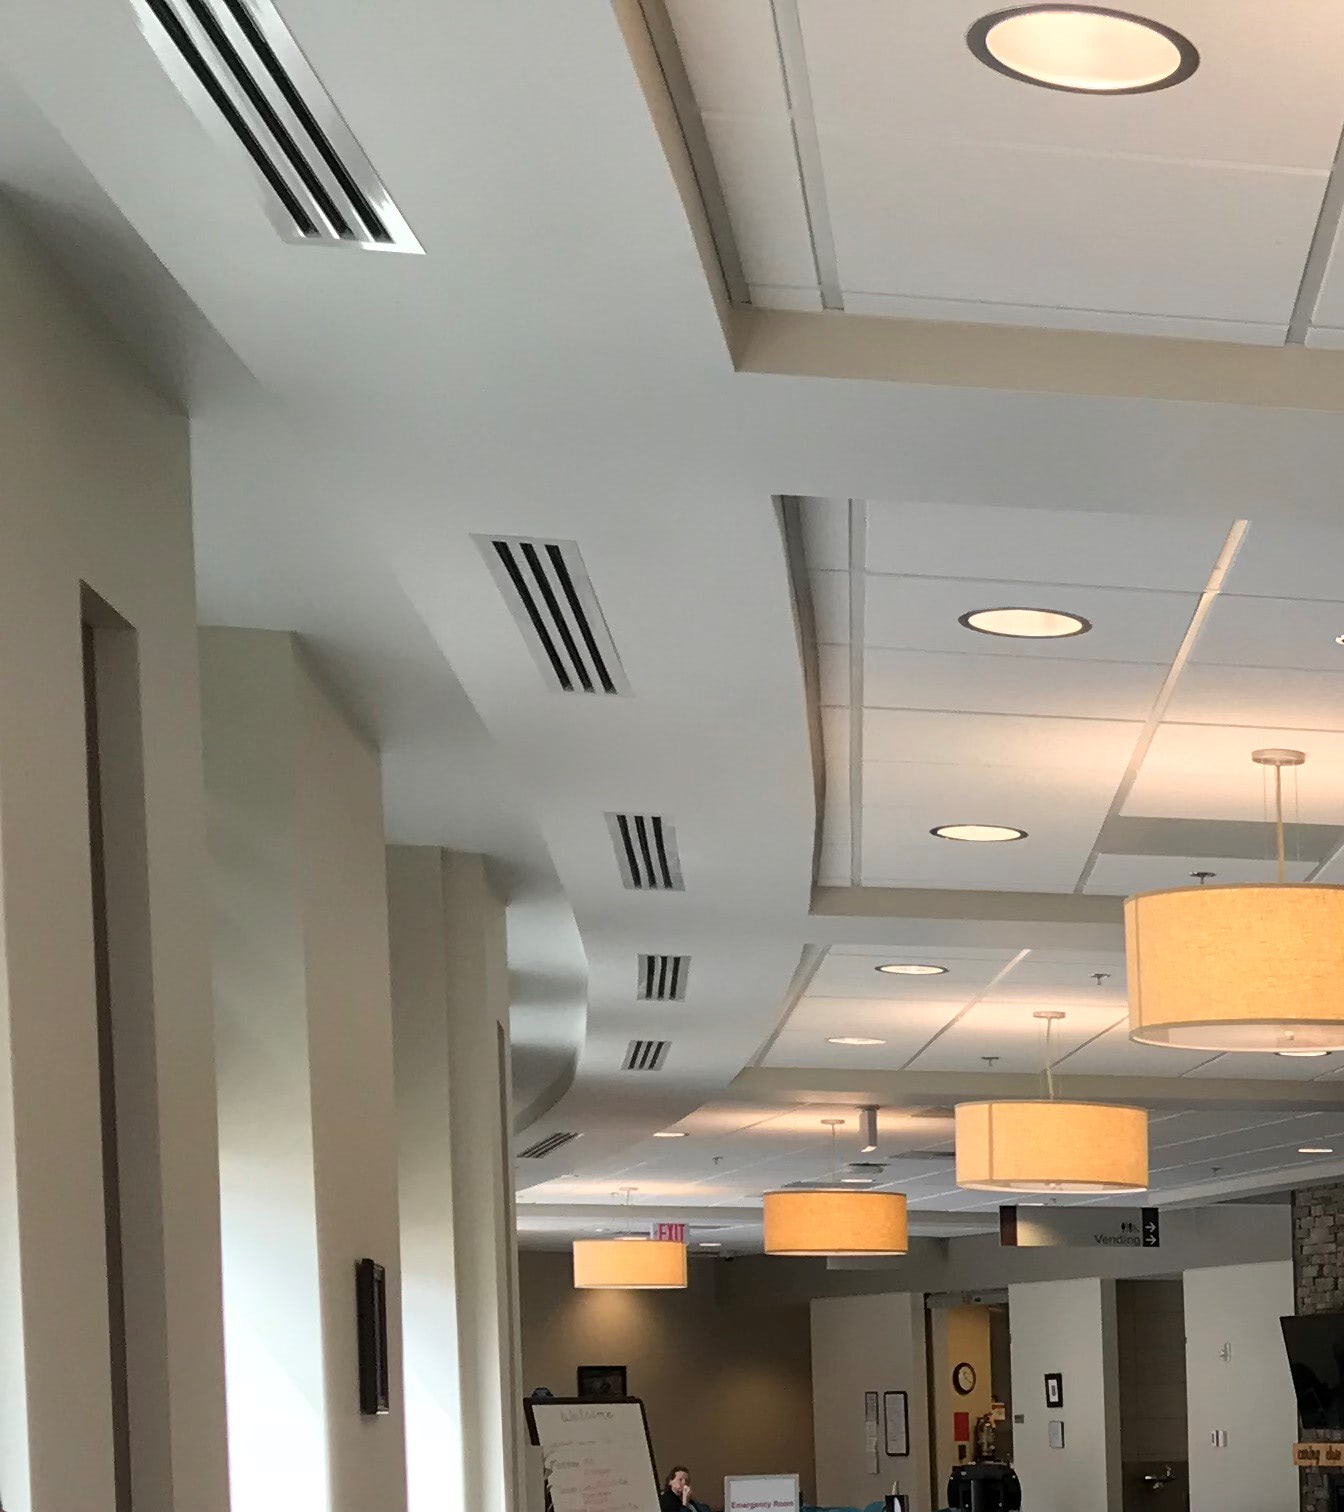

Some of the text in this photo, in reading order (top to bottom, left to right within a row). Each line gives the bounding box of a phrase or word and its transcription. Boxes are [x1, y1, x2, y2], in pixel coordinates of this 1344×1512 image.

[658, 1223, 685, 1241] EXIT
[1094, 1234, 1141, 1246] Vending
[731, 1501, 771, 1510] Emergency
